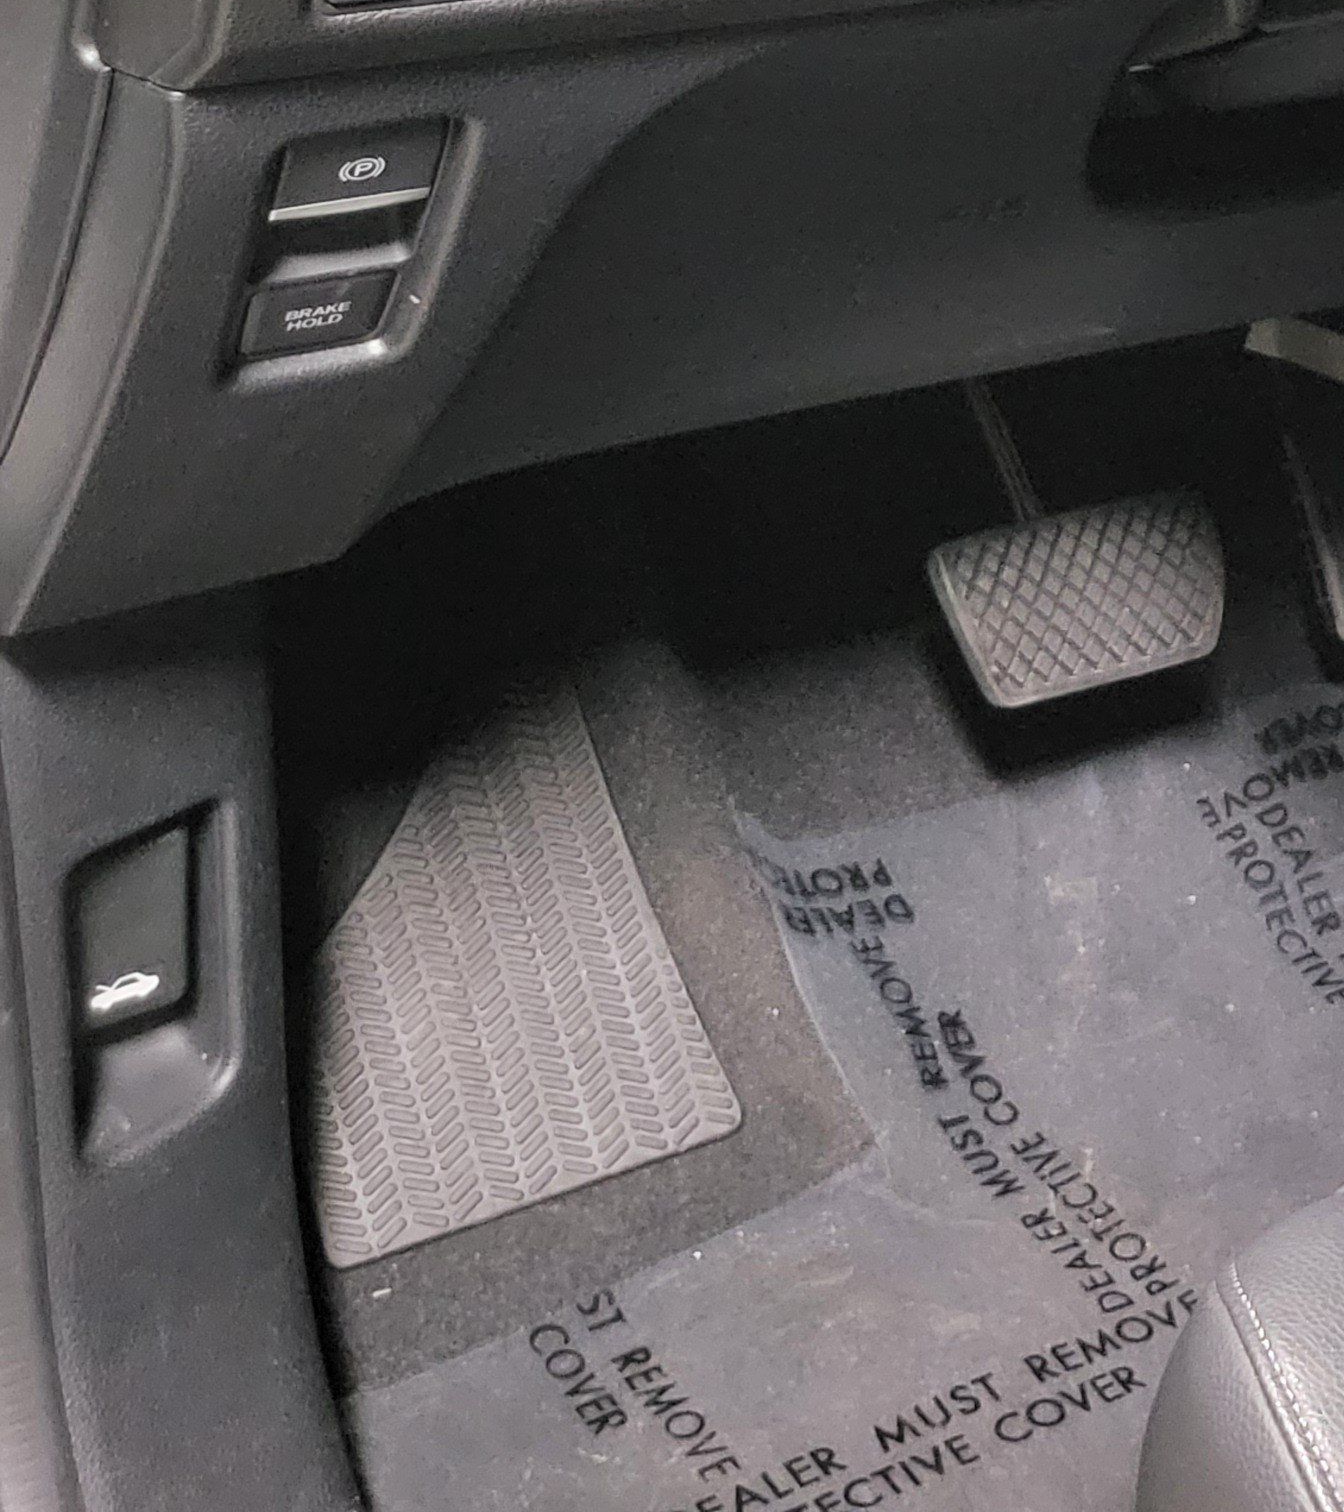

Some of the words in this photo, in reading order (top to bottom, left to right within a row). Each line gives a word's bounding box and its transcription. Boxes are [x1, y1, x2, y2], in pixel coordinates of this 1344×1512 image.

[285, 301, 352, 322] BRAKE
[286, 314, 344, 331] HOLD
[1256, 802, 1342, 936] DEALER
[850, 934, 949, 1091] REMOVE
[937, 1008, 1020, 1126] COVER
[936, 1114, 1026, 1199] MUST
[1009, 1131, 1182, 1296] PROTECTIVE
[1020, 1206, 1135, 1314] DEALER
[529, 1323, 629, 1436] COVER
[610, 1345, 742, 1483] REMOVE
[994, 1365, 1148, 1443] COVER
[672, 1447, 848, 1512] EALER
[873, 1372, 1001, 1454] MUST
